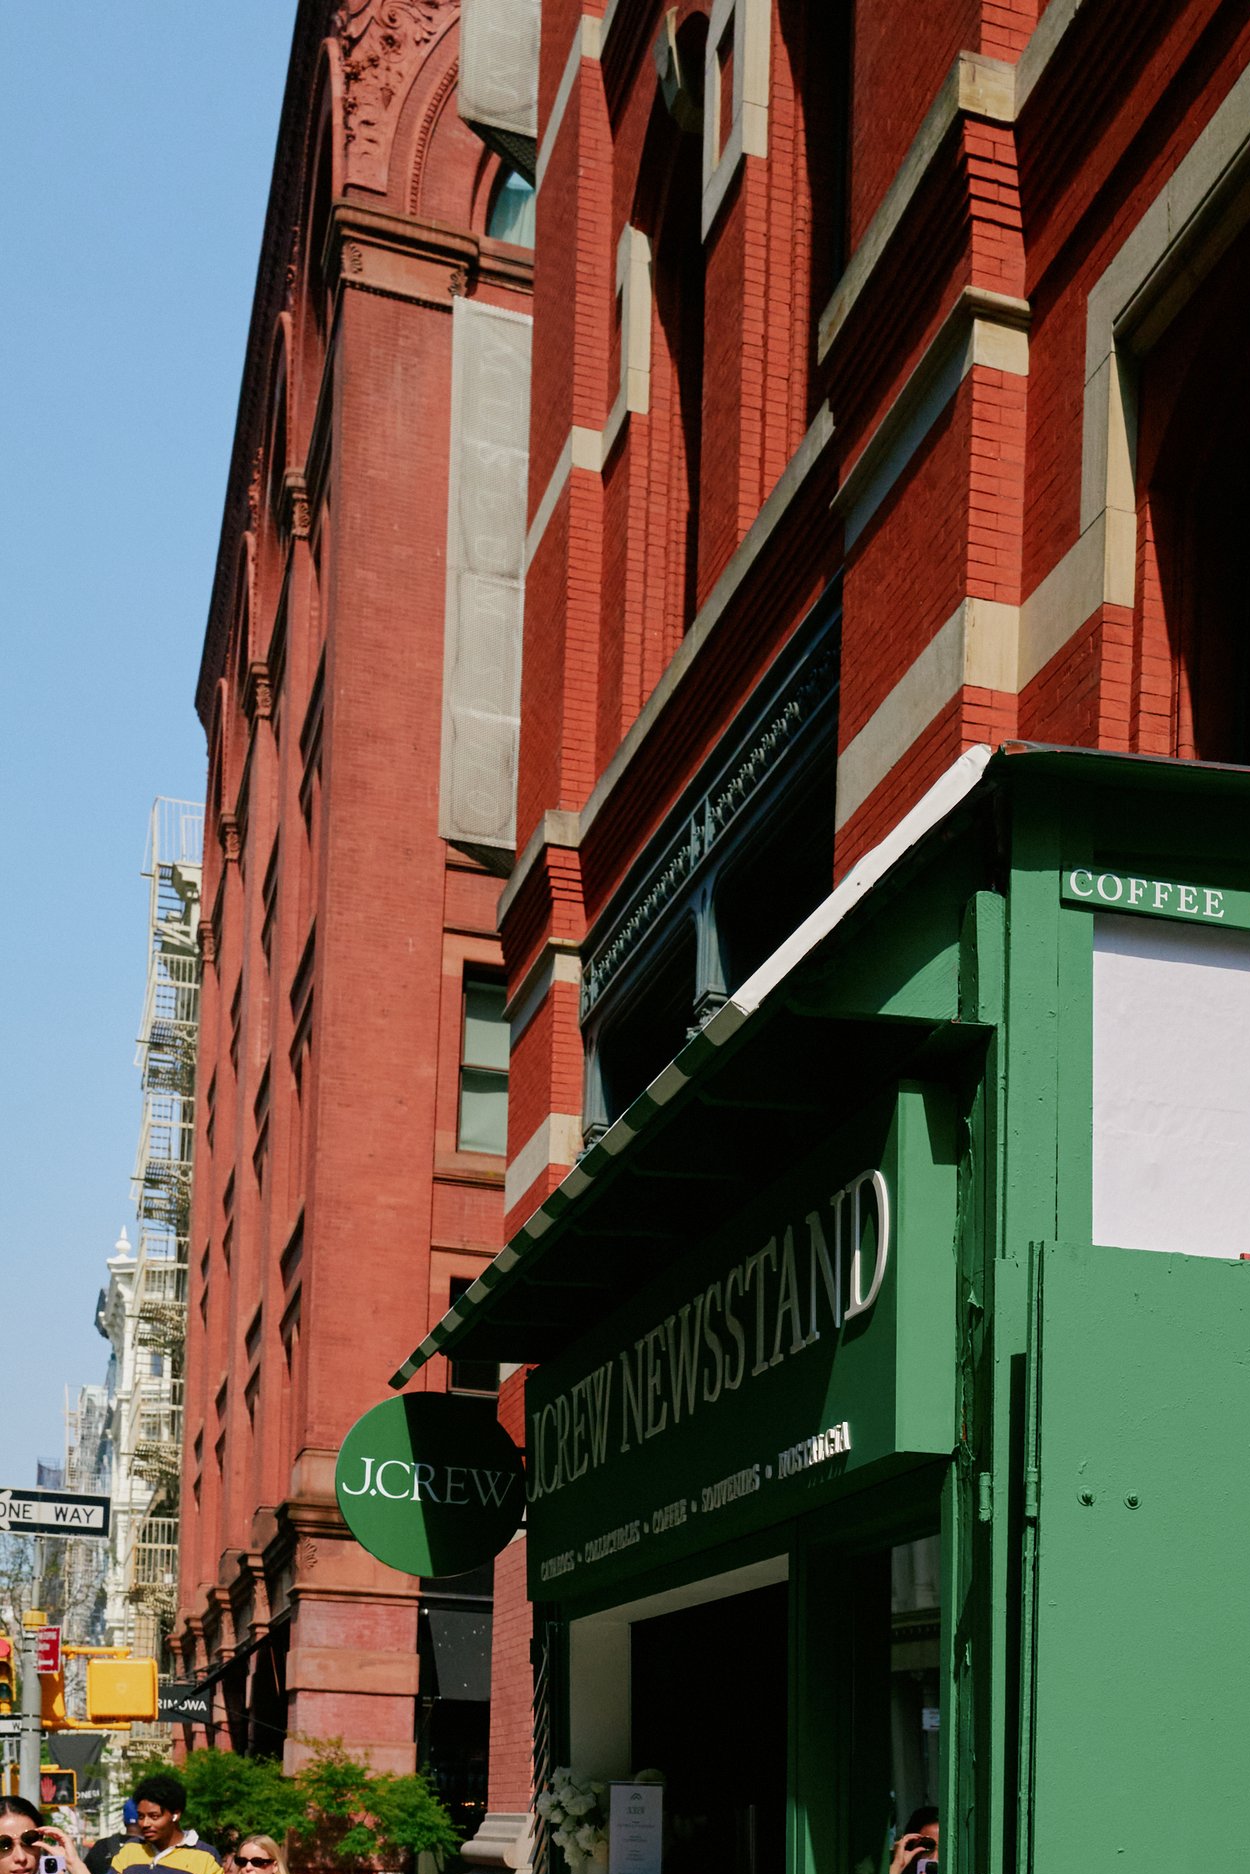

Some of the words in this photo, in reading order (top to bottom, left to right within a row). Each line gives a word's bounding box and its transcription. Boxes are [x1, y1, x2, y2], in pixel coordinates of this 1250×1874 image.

[1069, 868, 1225, 919] COFFEE
[619, 1169, 890, 1454] NEWSSTAND
[342, 1457, 516, 1508] J.CREW
[702, 1463, 760, 1513] SOUVENIRS
[778, 1421, 851, 1480] NOSTALGIA
[54, 1505, 95, 1524] WAY
